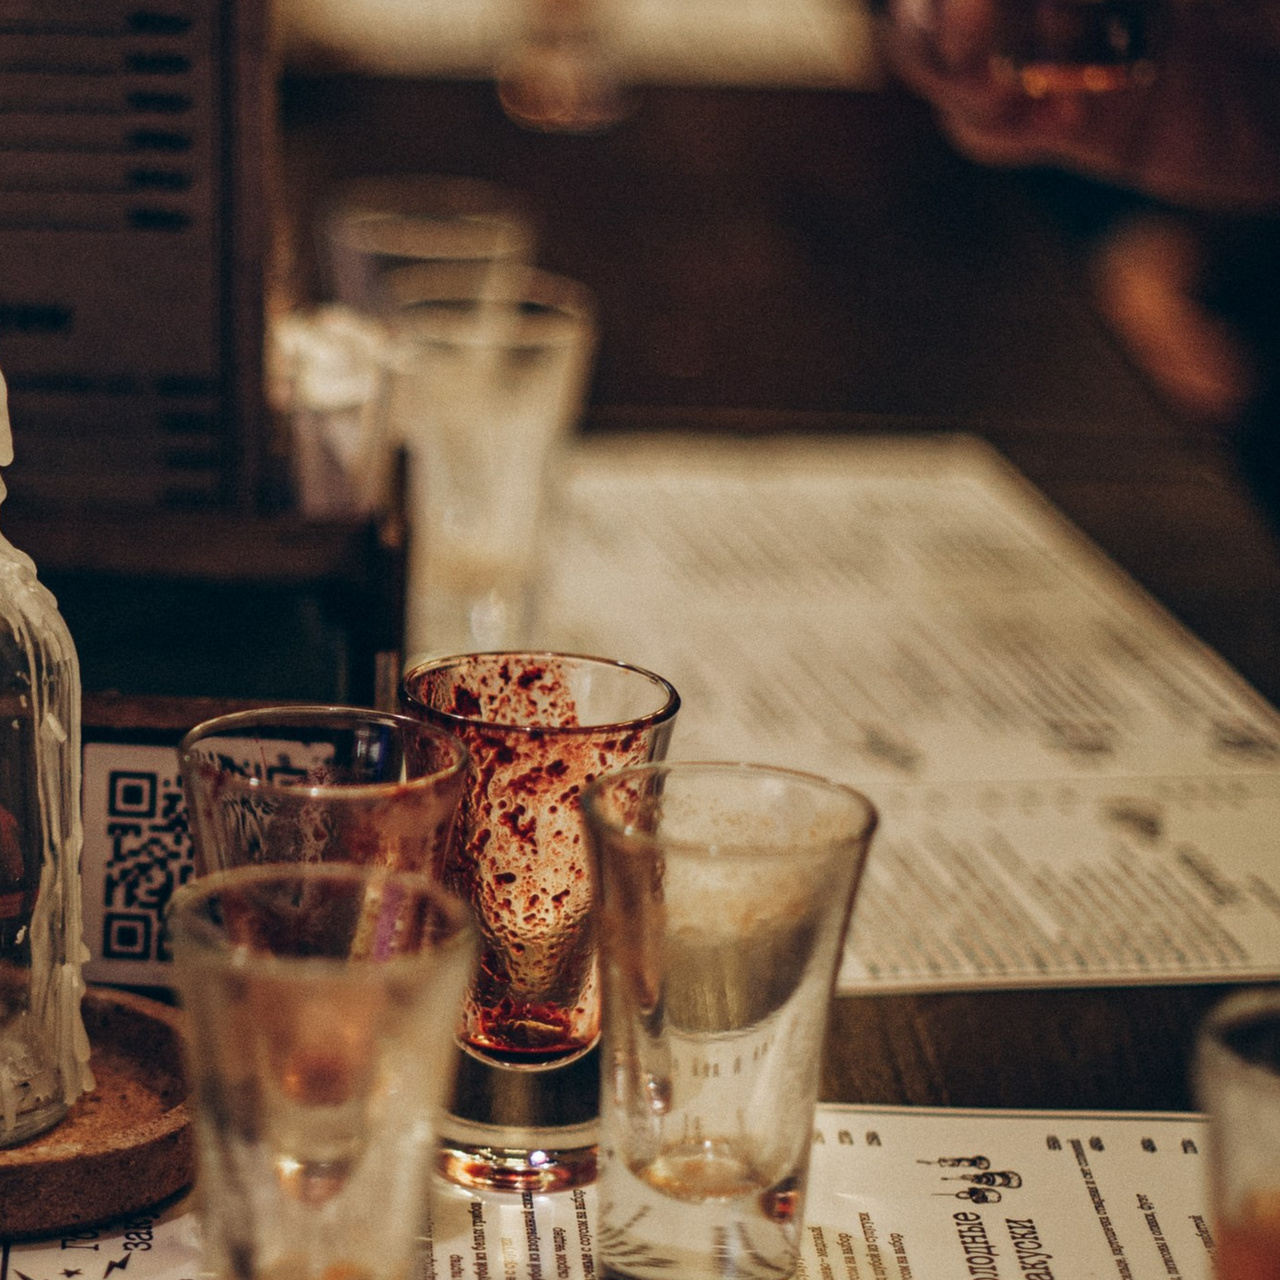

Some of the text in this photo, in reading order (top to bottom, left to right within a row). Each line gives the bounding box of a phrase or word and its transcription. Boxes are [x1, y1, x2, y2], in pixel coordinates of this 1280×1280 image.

[569, 1188, 586, 1210] выбор
[467, 1201, 486, 1227] грибов
[858, 1211, 879, 1242] сулугуни
[471, 1228, 485, 1250] белых
[522, 1210, 540, 1252] взорванной
[552, 1227, 567, 1252] чеддер
[577, 1220, 593, 1245] соусом
[836, 1232, 855, 1255] выбор
[888, 1232, 907, 1255] выбор
[1099, 1216, 1125, 1256] картошечка
[556, 1253, 570, 1279] сыром
[865, 1252, 888, 1276] шубой
